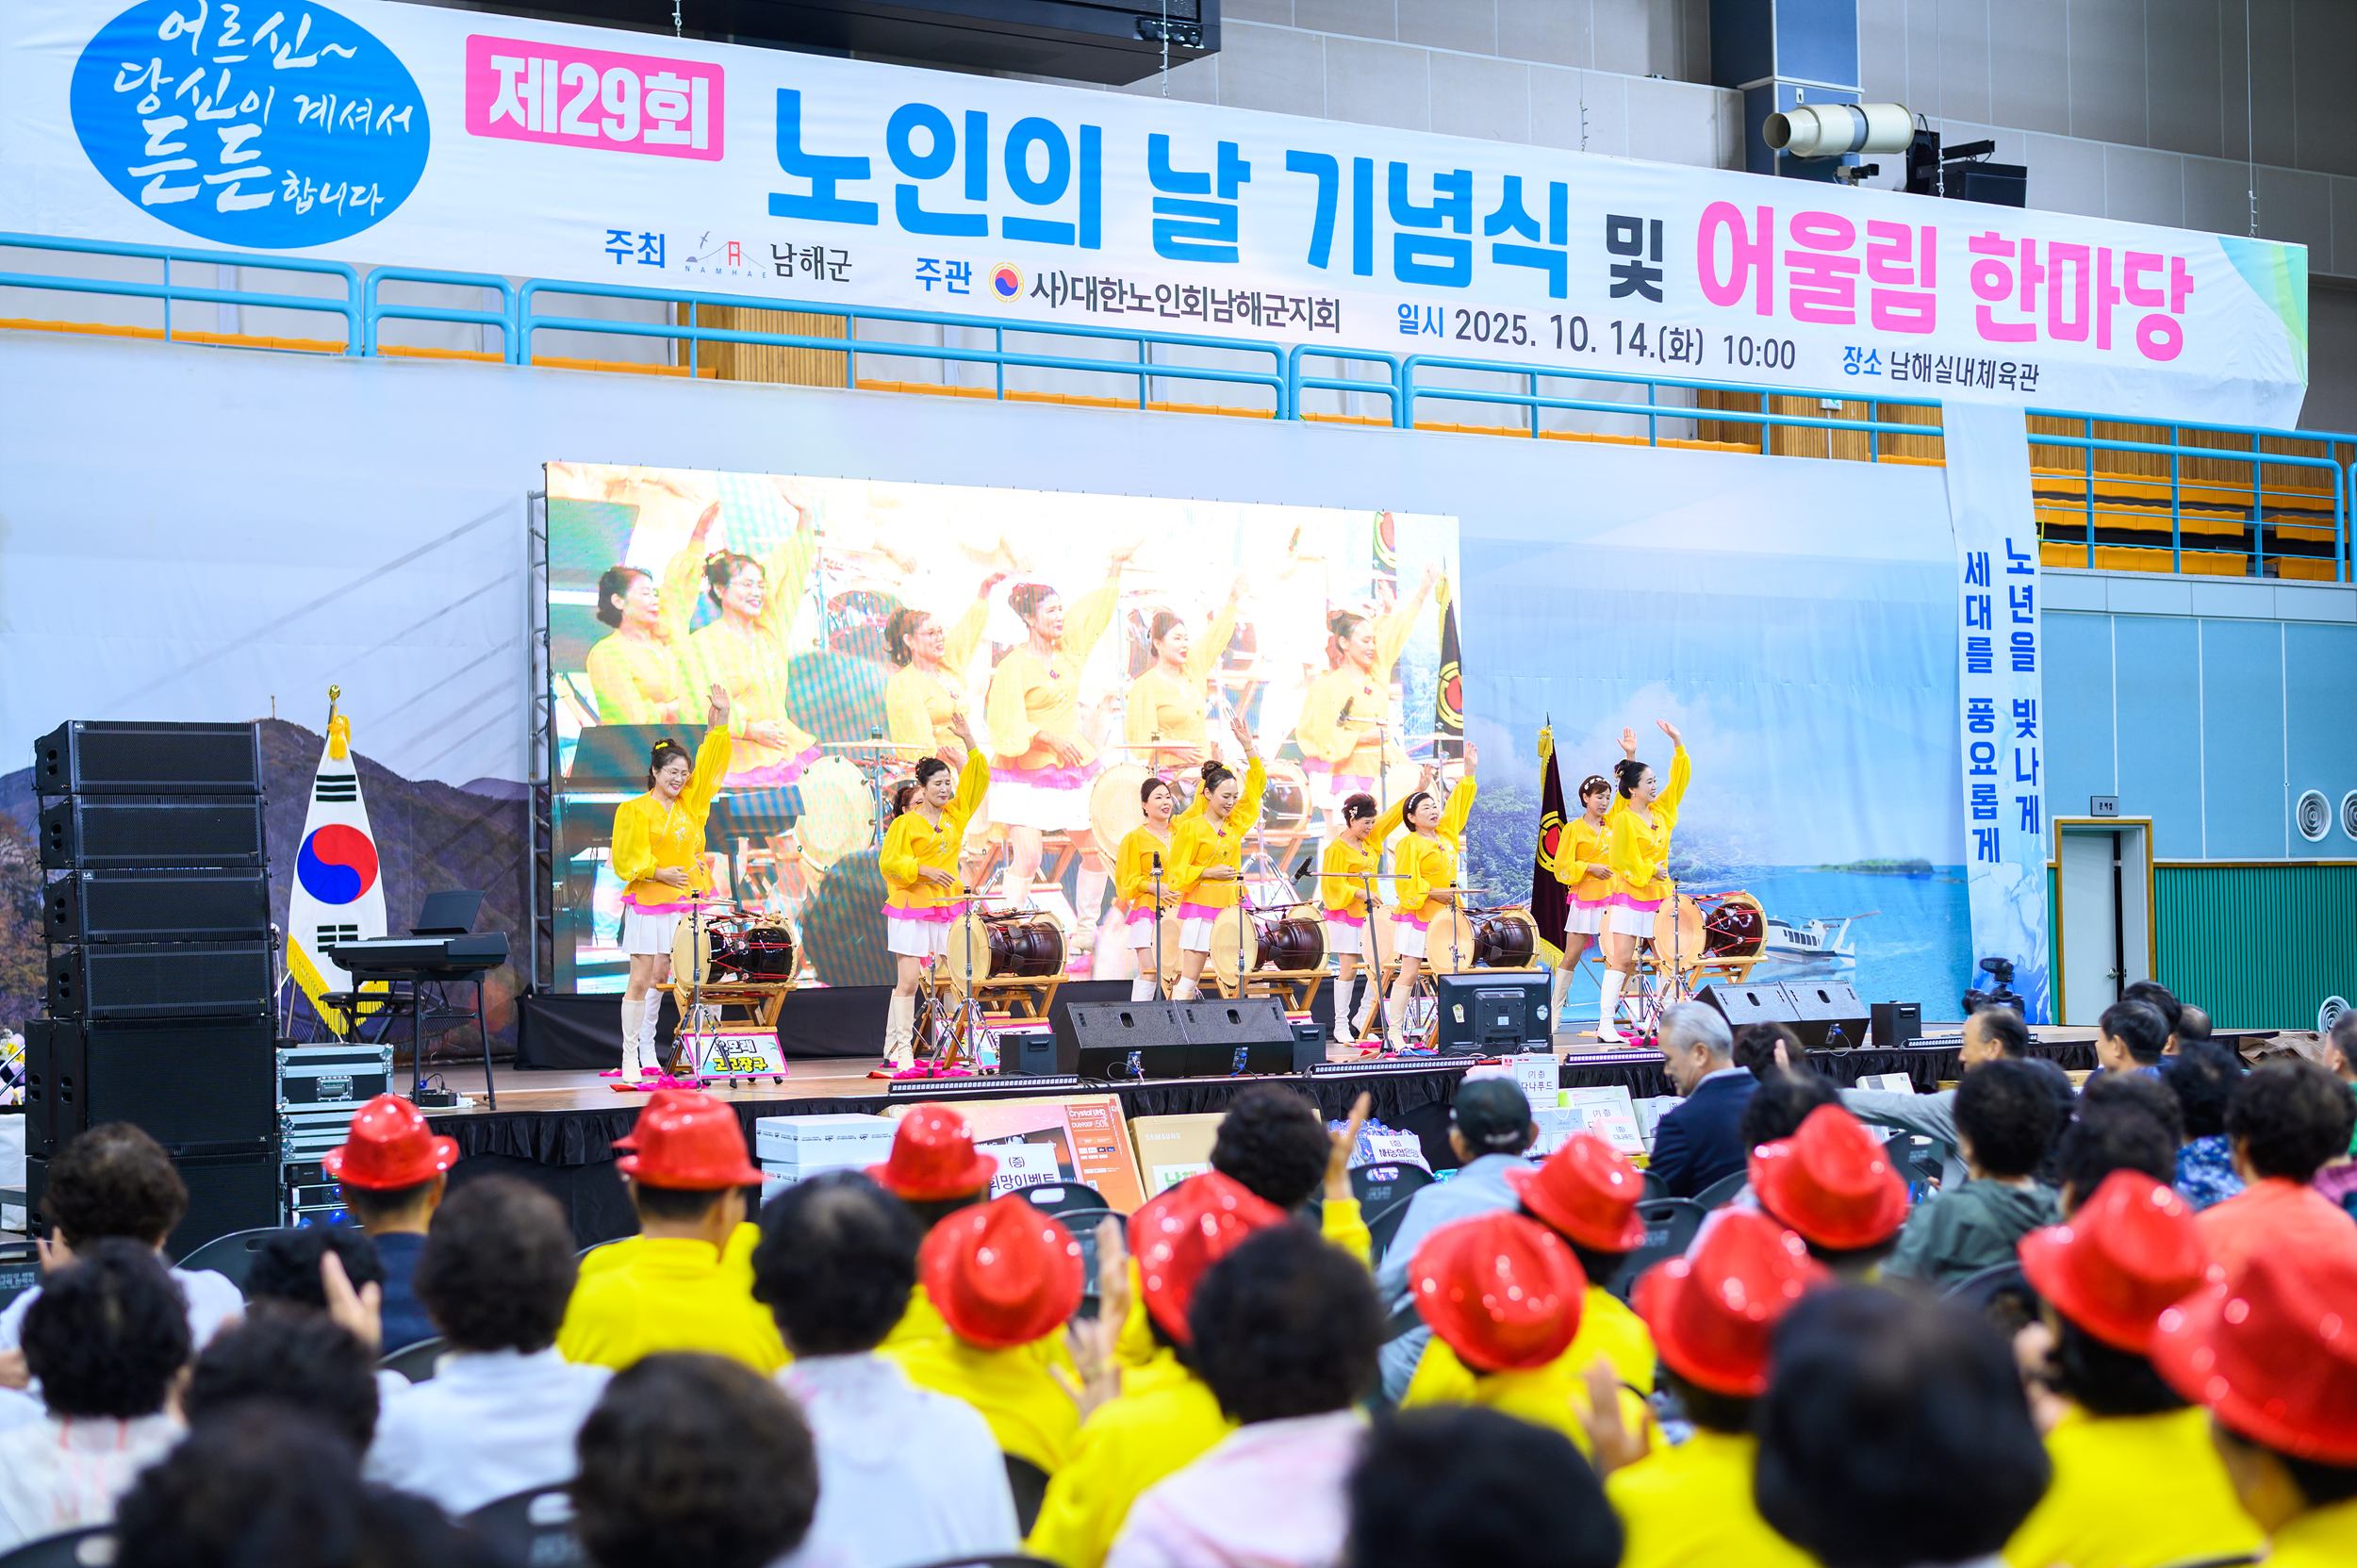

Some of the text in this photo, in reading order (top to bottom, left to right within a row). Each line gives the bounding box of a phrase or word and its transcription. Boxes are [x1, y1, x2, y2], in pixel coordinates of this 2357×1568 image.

[157, 0, 358, 70] 어르신~
[113, 58, 414, 136] 당신이 계셔서
[489, 54, 2195, 362] 제29회 노인의 날 기념식 및 어울림 한마당
[604, 229, 666, 269] 주최
[769, 241, 853, 283] 남해군
[915, 256, 1341, 334] 주관 사)대한노인회남해군지회
[1397, 304, 1796, 371] 일시 2025. 10. 14.(화) 10:00
[1843, 345, 2039, 392] 장소 남해실내체육관
[1965, 552, 2001, 863] 세대를 풍요롭게
[2005, 537, 2039, 834] 노년을 빛나게
[1146, 1132, 1180, 1141] SAMSUNG
